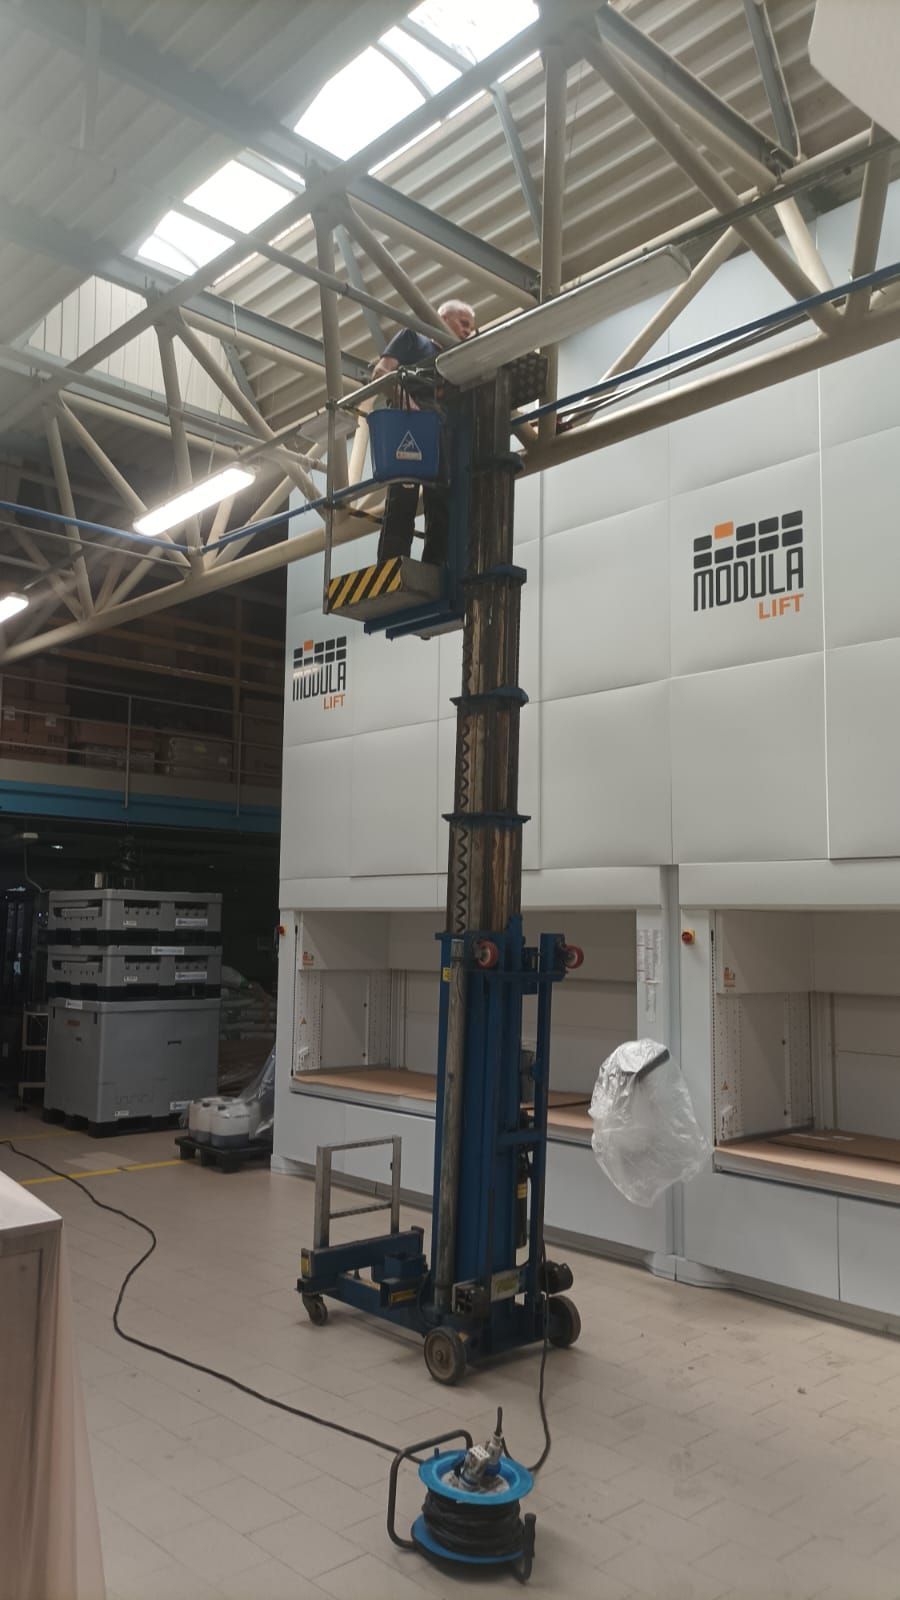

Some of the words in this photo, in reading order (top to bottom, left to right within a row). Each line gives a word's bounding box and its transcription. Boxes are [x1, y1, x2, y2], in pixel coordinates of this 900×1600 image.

[693, 546, 804, 612] MODULA
[758, 593, 804, 620] LIFT
[323, 694, 345, 710] LIFT
